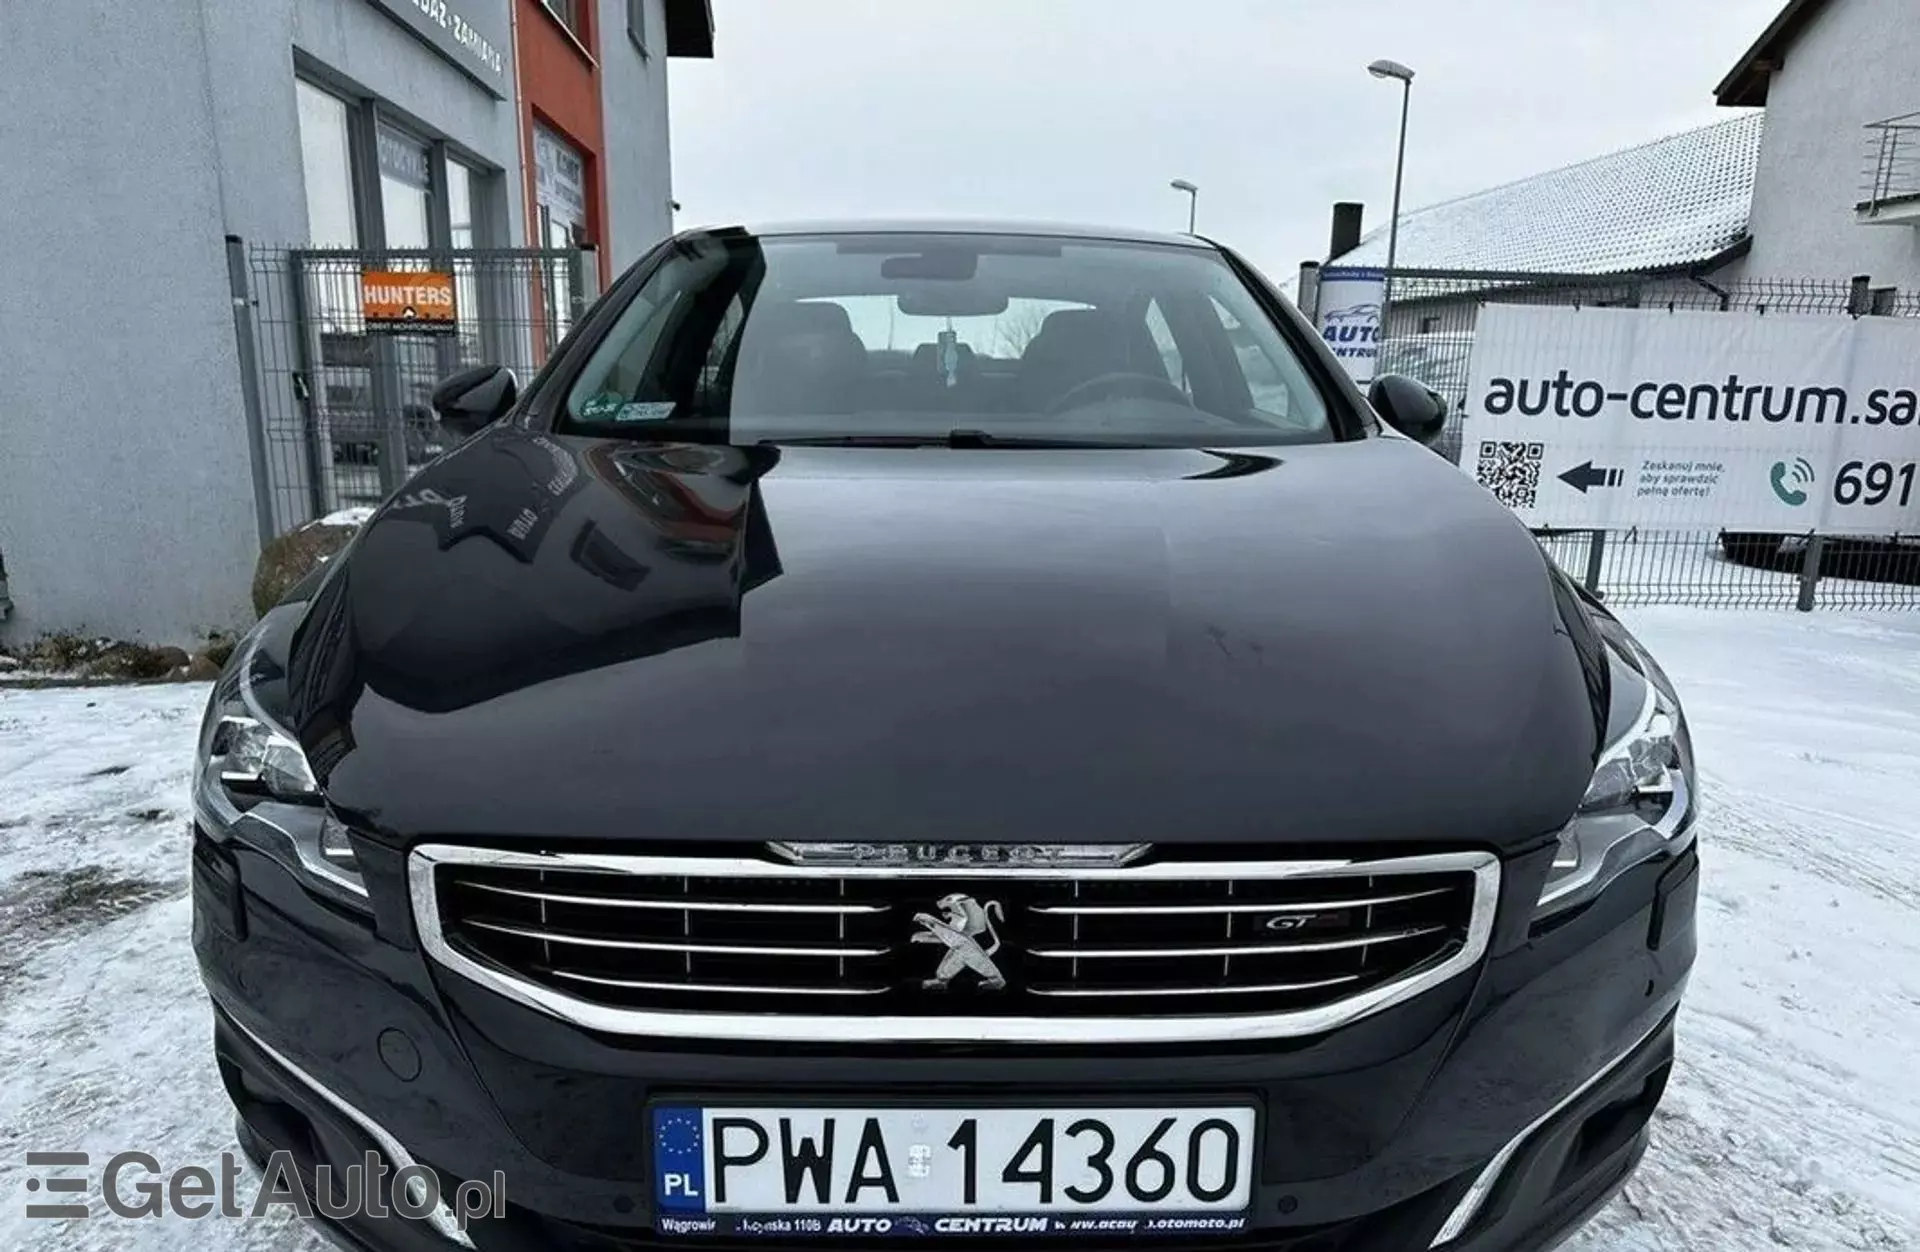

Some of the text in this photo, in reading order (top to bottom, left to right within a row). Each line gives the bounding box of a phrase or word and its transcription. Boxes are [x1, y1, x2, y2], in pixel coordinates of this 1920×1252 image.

[363, 285, 452, 305] HUNTERS
[1484, 370, 1920, 426] auto-centrum.sa
[1642, 460, 1693, 472] Zeskanuj
[1640, 474, 1661, 484] aby
[1834, 461, 1916, 506] 691
[1266, 914, 1316, 929] GT
[712, 1118, 1239, 1203] PWA 14360
[664, 1173, 698, 1196] PL
[795, 1219, 821, 1231] 110B
[827, 1217, 892, 1233] AUTO
[934, 1217, 1048, 1233] CENTRUM
